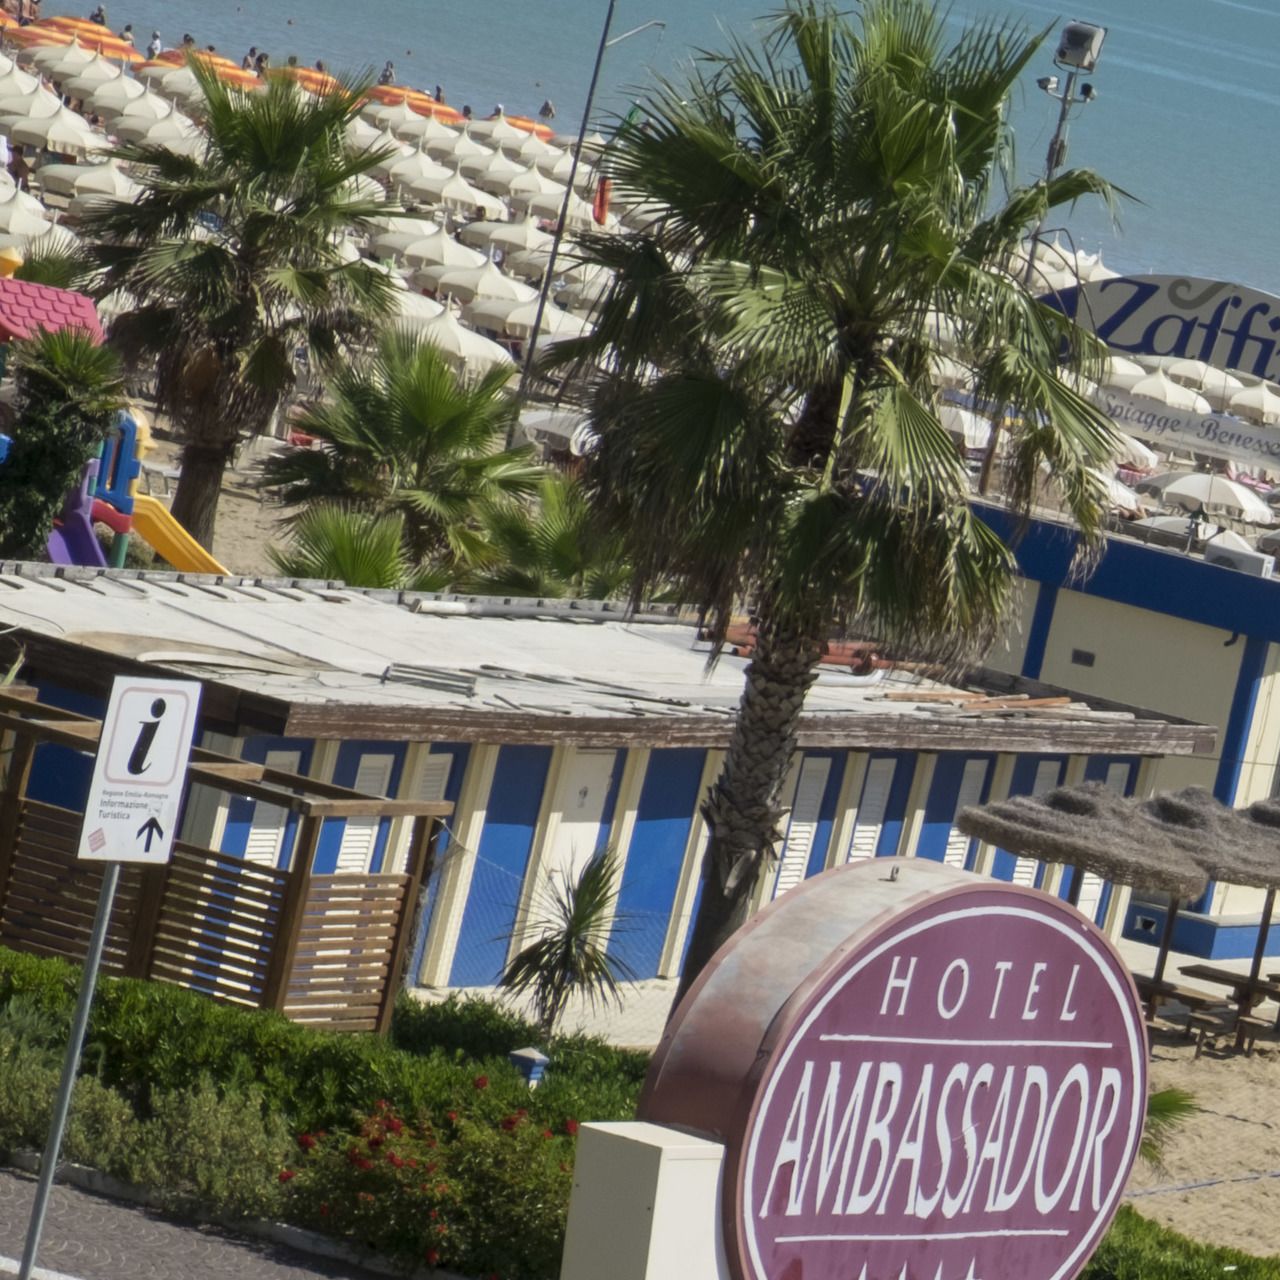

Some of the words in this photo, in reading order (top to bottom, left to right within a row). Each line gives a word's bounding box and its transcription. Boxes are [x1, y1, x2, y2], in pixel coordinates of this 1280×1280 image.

[1103, 393, 1182, 434] Spiagge
[98, 810, 131, 820] Turistica
[879, 955, 1079, 1022] HOTEL
[760, 1060, 1122, 1221] AMBASSADOR
